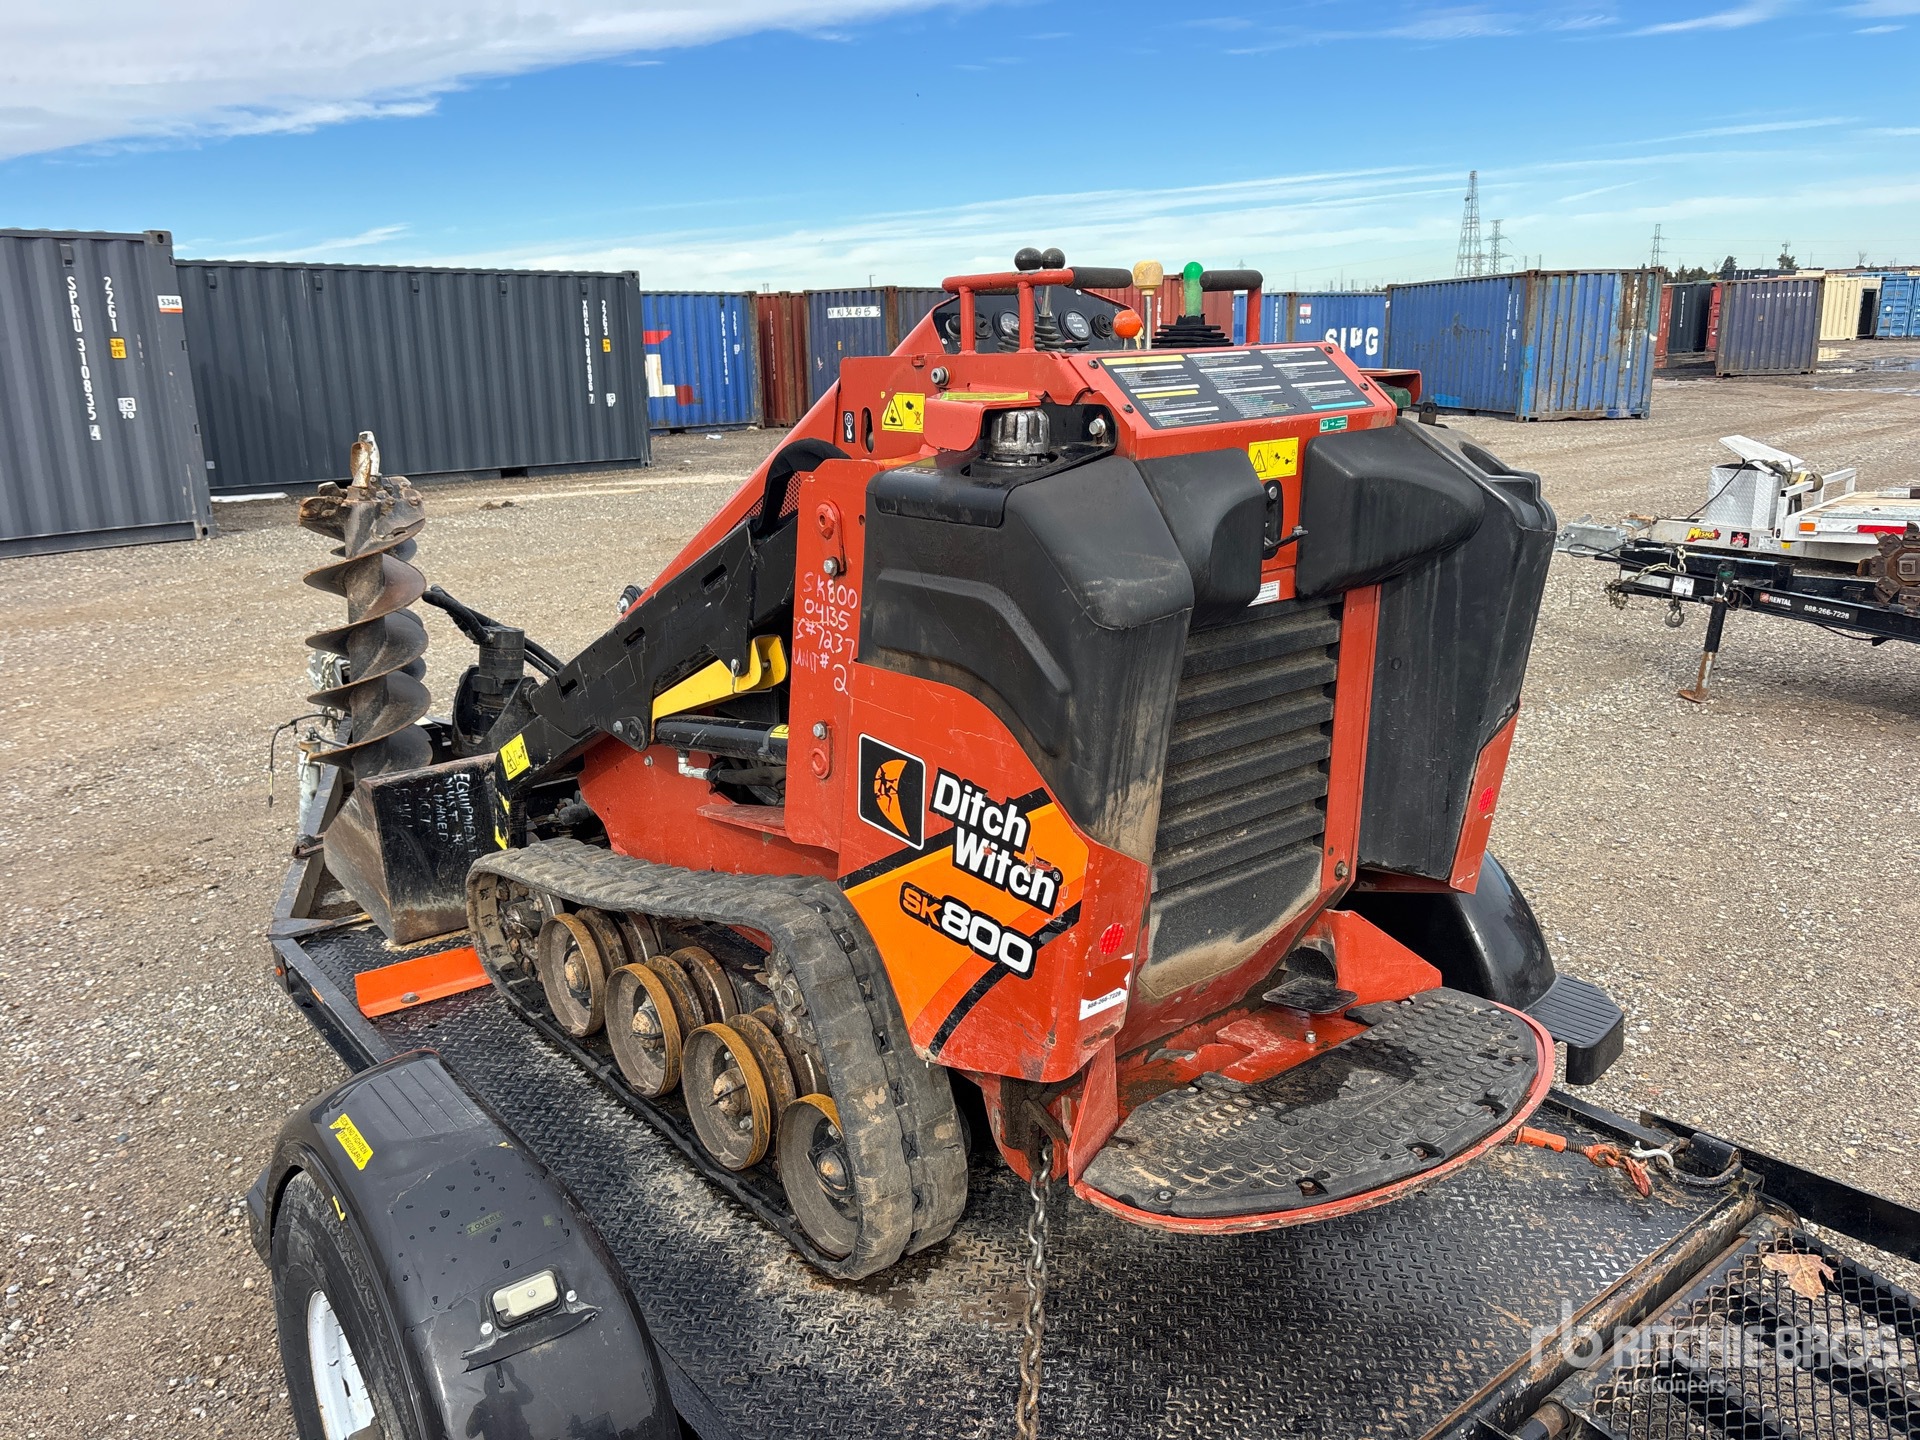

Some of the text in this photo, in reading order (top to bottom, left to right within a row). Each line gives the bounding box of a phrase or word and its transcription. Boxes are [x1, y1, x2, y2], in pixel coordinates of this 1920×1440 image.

[104, 276, 118, 332] 22G1
[67, 276, 101, 440] SPRU 310835 4
[804, 598, 850, 631] 04135
[1769, 596, 1792, 606] RENTAL
[1803, 604, 1850, 620] 888-266-7228
[833, 664, 848, 695] 2
[443, 777, 459, 822] MUST
[454, 773, 478, 852] EQUIPMENT
[933, 773, 1027, 848] Ditch
[902, 887, 1034, 973] SK800
[1087, 990, 1122, 1010] 888-266-7228
[344, 1138, 364, 1163] REGULARLY
[352, 1134, 368, 1154] TIGHTEN
